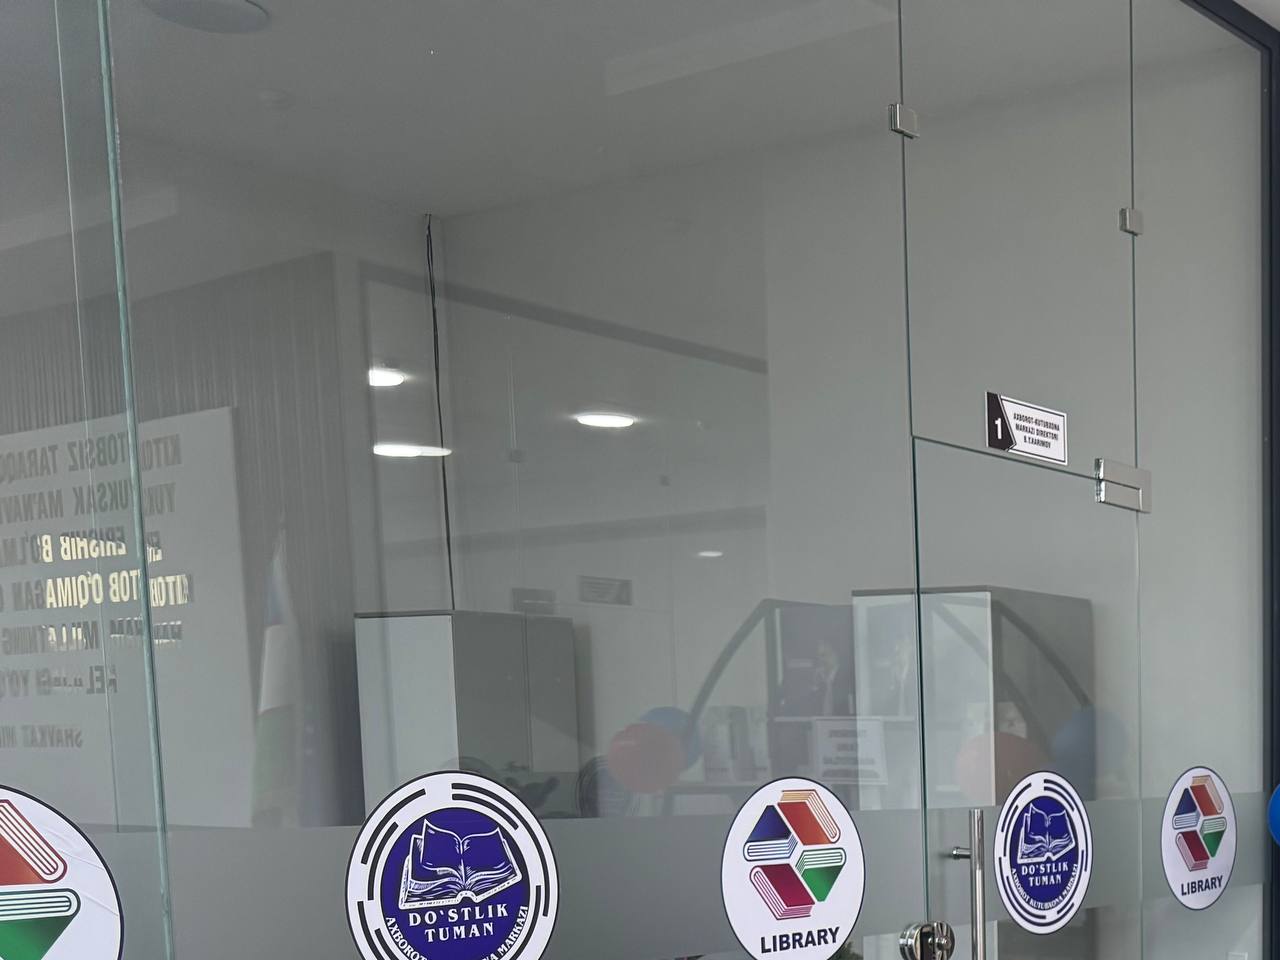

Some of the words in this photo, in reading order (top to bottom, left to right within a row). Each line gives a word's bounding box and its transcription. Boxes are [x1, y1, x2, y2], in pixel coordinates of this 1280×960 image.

[994, 417, 1002, 440] 1
[1028, 874, 1062, 887] TUMAN
[1181, 875, 1223, 896] LIBRARY
[424, 922, 494, 942] TUMAN
[497, 905, 529, 959] MARKAZI
[760, 926, 840, 954] LIBRARY
